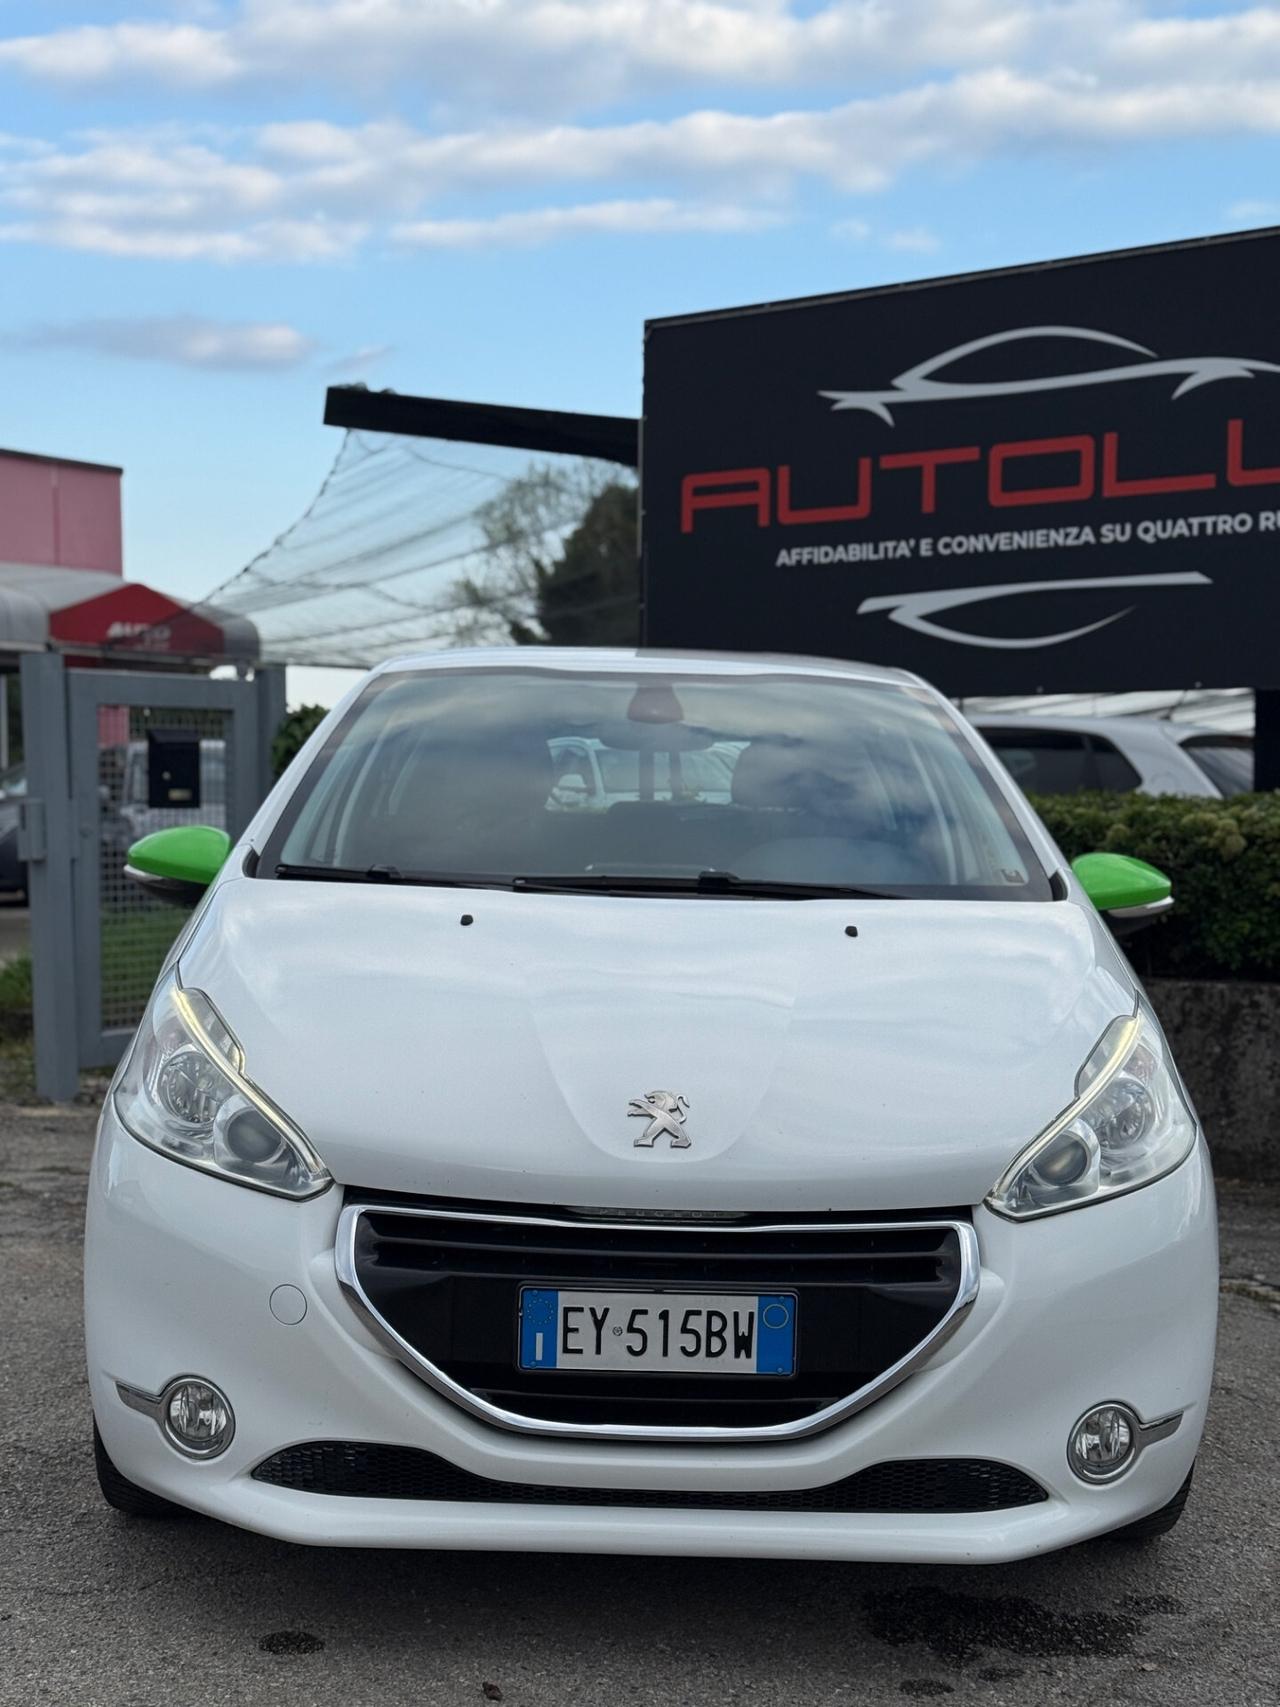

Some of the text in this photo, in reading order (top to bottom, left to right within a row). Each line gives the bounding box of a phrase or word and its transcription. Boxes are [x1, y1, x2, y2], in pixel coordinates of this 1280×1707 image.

[776, 510, 1280, 567] AFFIDABILITA' E CONVENIENZA SU QUATTRO R
[626, 1308, 755, 1359] 515BW
